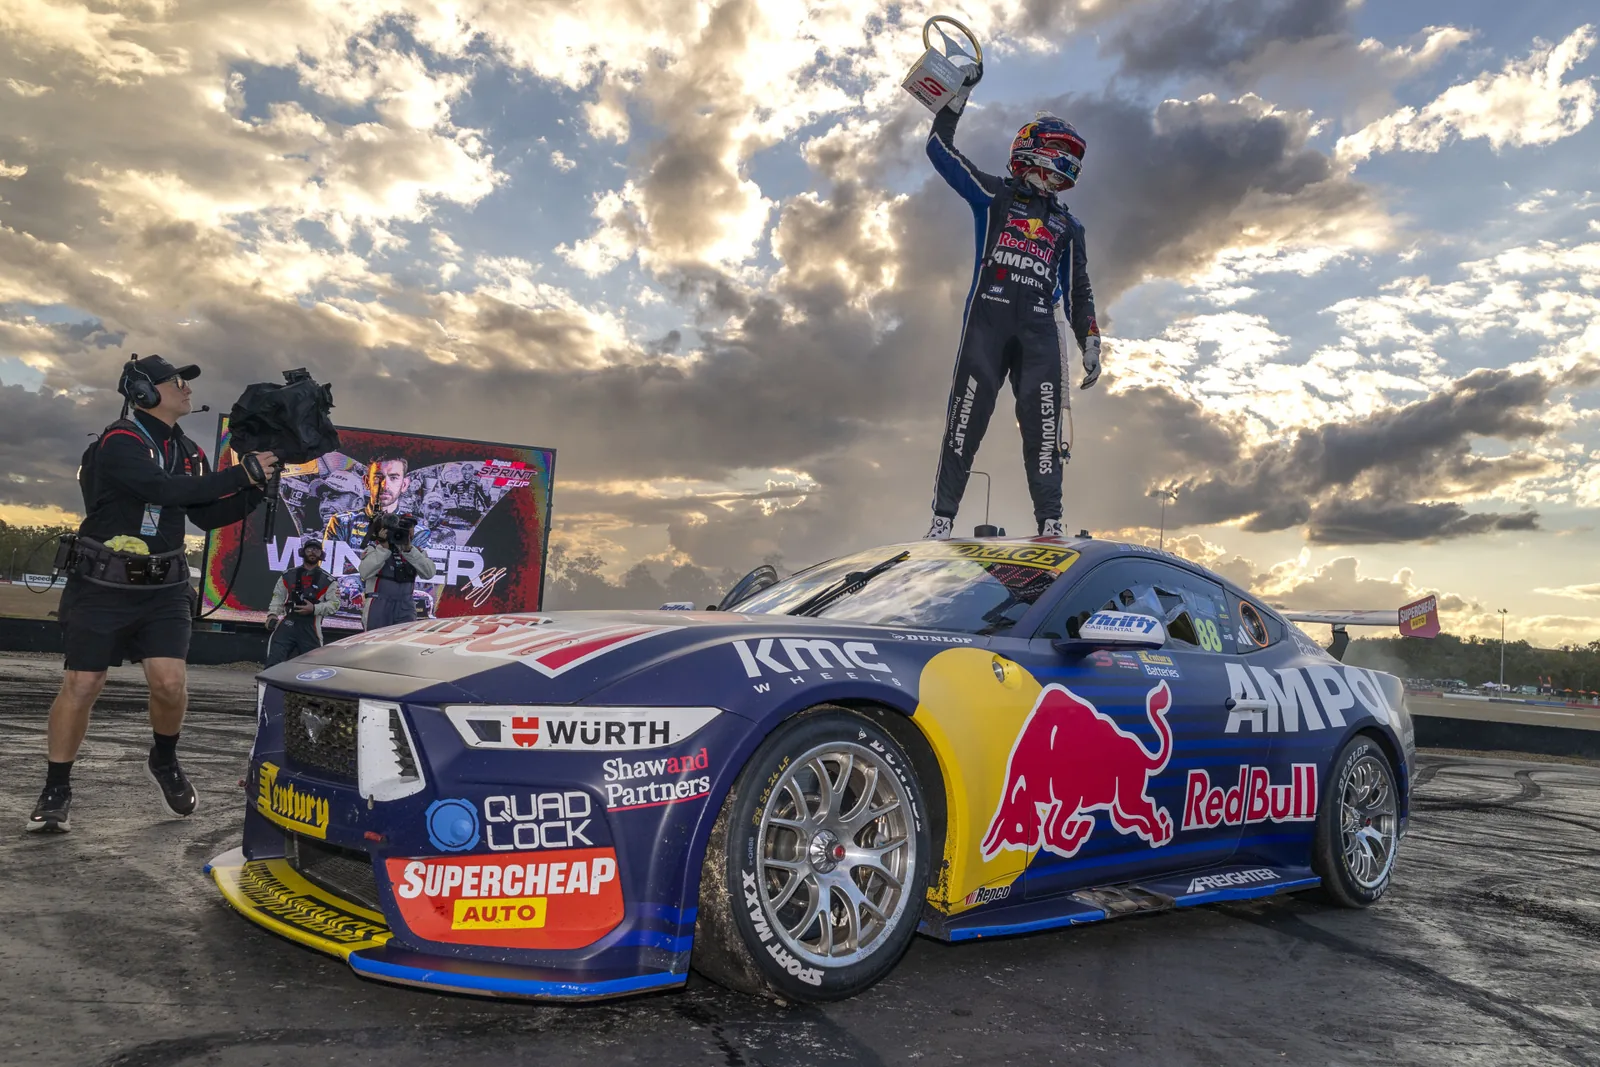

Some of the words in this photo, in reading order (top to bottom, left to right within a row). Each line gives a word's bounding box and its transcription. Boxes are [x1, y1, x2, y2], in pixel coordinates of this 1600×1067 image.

[1040, 382, 1055, 415] GIVES
[954, 386, 976, 457] AMPLIFY
[1042, 415, 1056, 440] YOU
[480, 467, 537, 479] SPRINT
[906, 634, 973, 644] DUNLOP
[1087, 614, 1157, 634] Thrifty
[1195, 617, 1223, 653] 88
[753, 672, 902, 694] WHEELS
[1144, 664, 1180, 678] Batteries
[1224, 662, 1402, 733] AMPOL
[546, 720, 670, 745] WÜRTH
[1338, 744, 1369, 793] DUNLOP
[484, 791, 592, 823] QUAD
[605, 776, 710, 809] Partners
[1181, 763, 1249, 831] Red
[1246, 763, 1318, 826] Bull
[486, 818, 594, 850] LOCK
[398, 857, 616, 899] SUPERCHEAP
[1194, 868, 1281, 893] FREIGHTER
[742, 869, 775, 941] MAXX
[975, 885, 1011, 905] Repco
[462, 904, 536, 922] AUTO
[766, 944, 826, 987] SPORT
